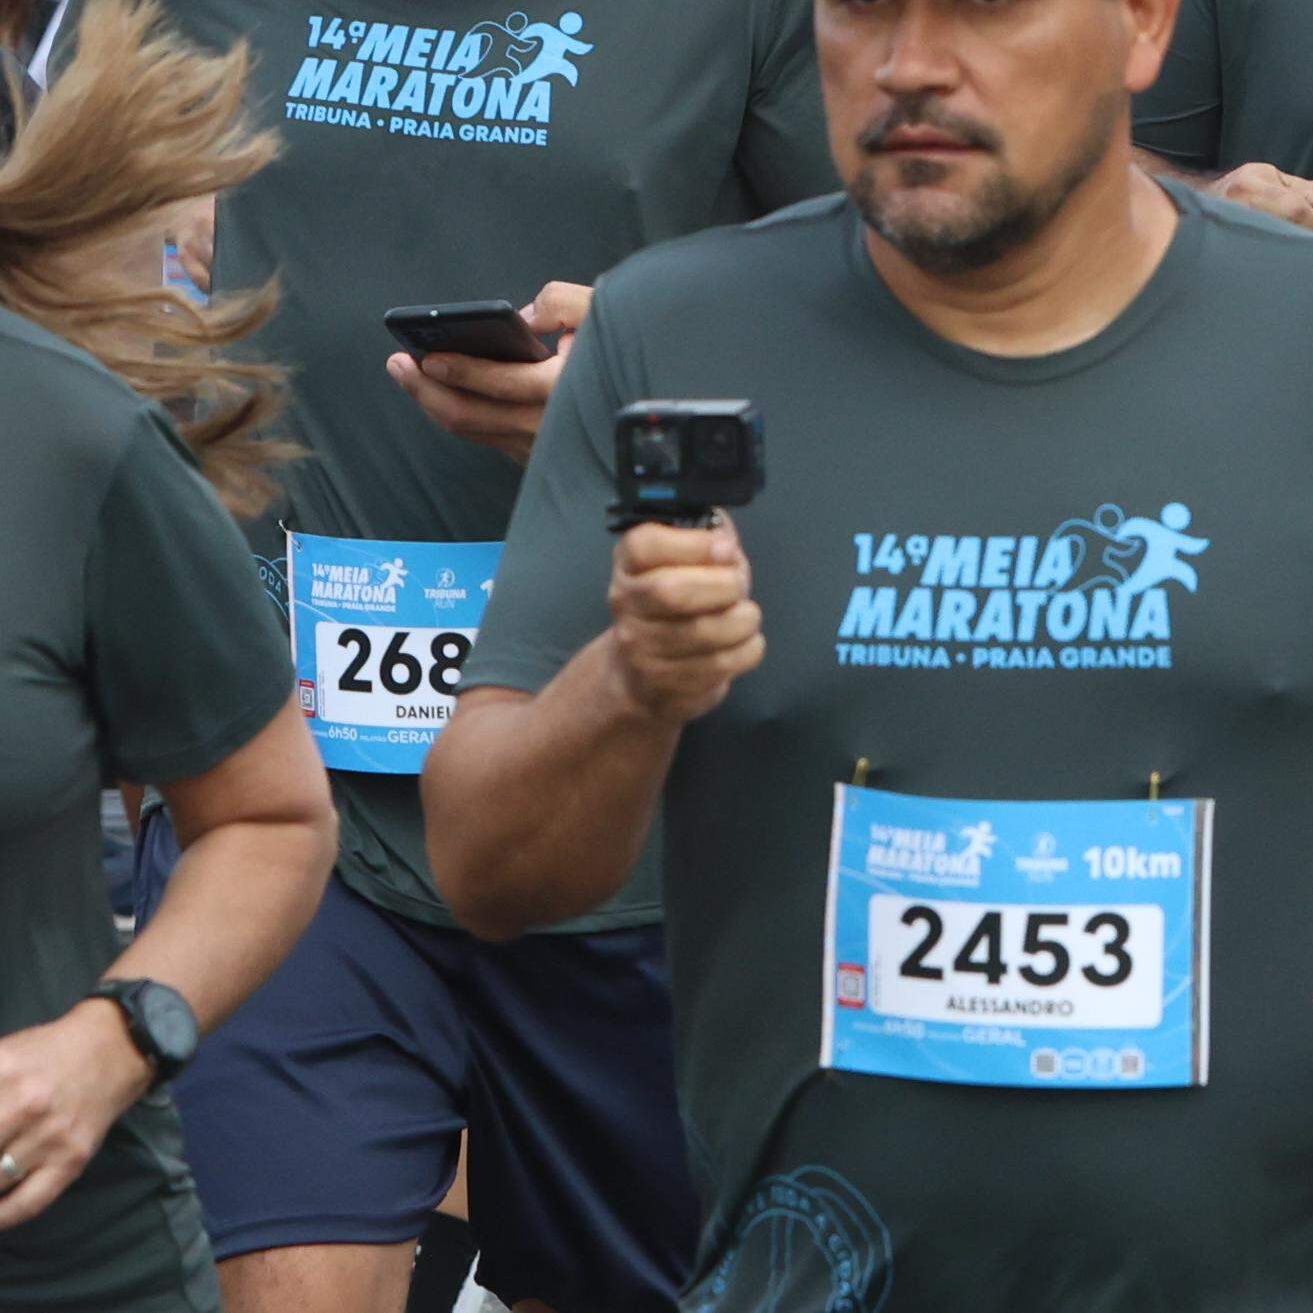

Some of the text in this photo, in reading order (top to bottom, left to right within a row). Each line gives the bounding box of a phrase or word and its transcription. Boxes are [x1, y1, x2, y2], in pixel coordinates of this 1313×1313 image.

[356, 22, 484, 74] MEIA
[288, 57, 550, 123] MARATONA
[285, 102, 547, 147] TRIBUNA PRAIA GRANDE
[328, 566, 369, 583] MEIA
[920, 535, 1076, 587] MEIA
[311, 580, 396, 604] MARATONA
[424, 588, 466, 601] TRIBUNA
[836, 586, 1171, 642] MARATONA
[835, 643, 1172, 669] TRIBUNA PRAIA GRANDE
[328, 725, 358, 741] 6h50
[1083, 846, 1182, 879] 10km
[899, 905, 1134, 988] 2453
[945, 997, 1075, 1017] ALESSANDRO
